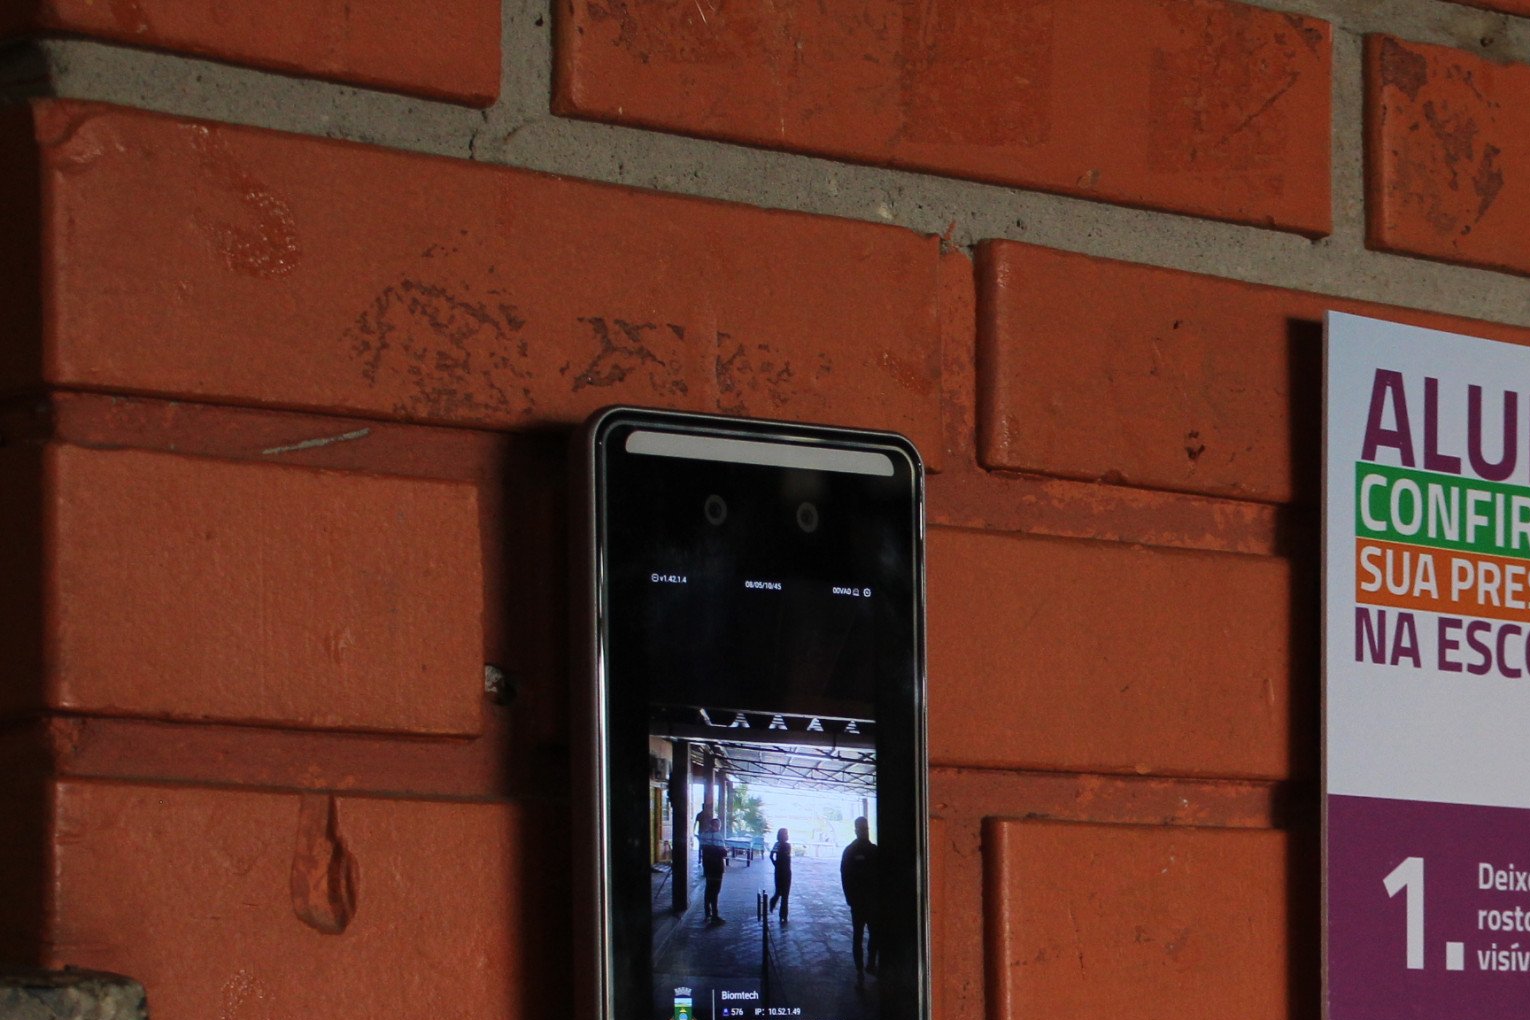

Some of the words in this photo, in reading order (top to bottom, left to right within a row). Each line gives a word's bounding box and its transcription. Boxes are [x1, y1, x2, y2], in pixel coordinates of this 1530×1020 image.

[1359, 546, 1438, 599] SUA
[1355, 606, 1421, 668] NA
[1382, 856, 1464, 971] 1.
[721, 990, 759, 1000] Biomtech
[731, 1007, 744, 1016] 576
